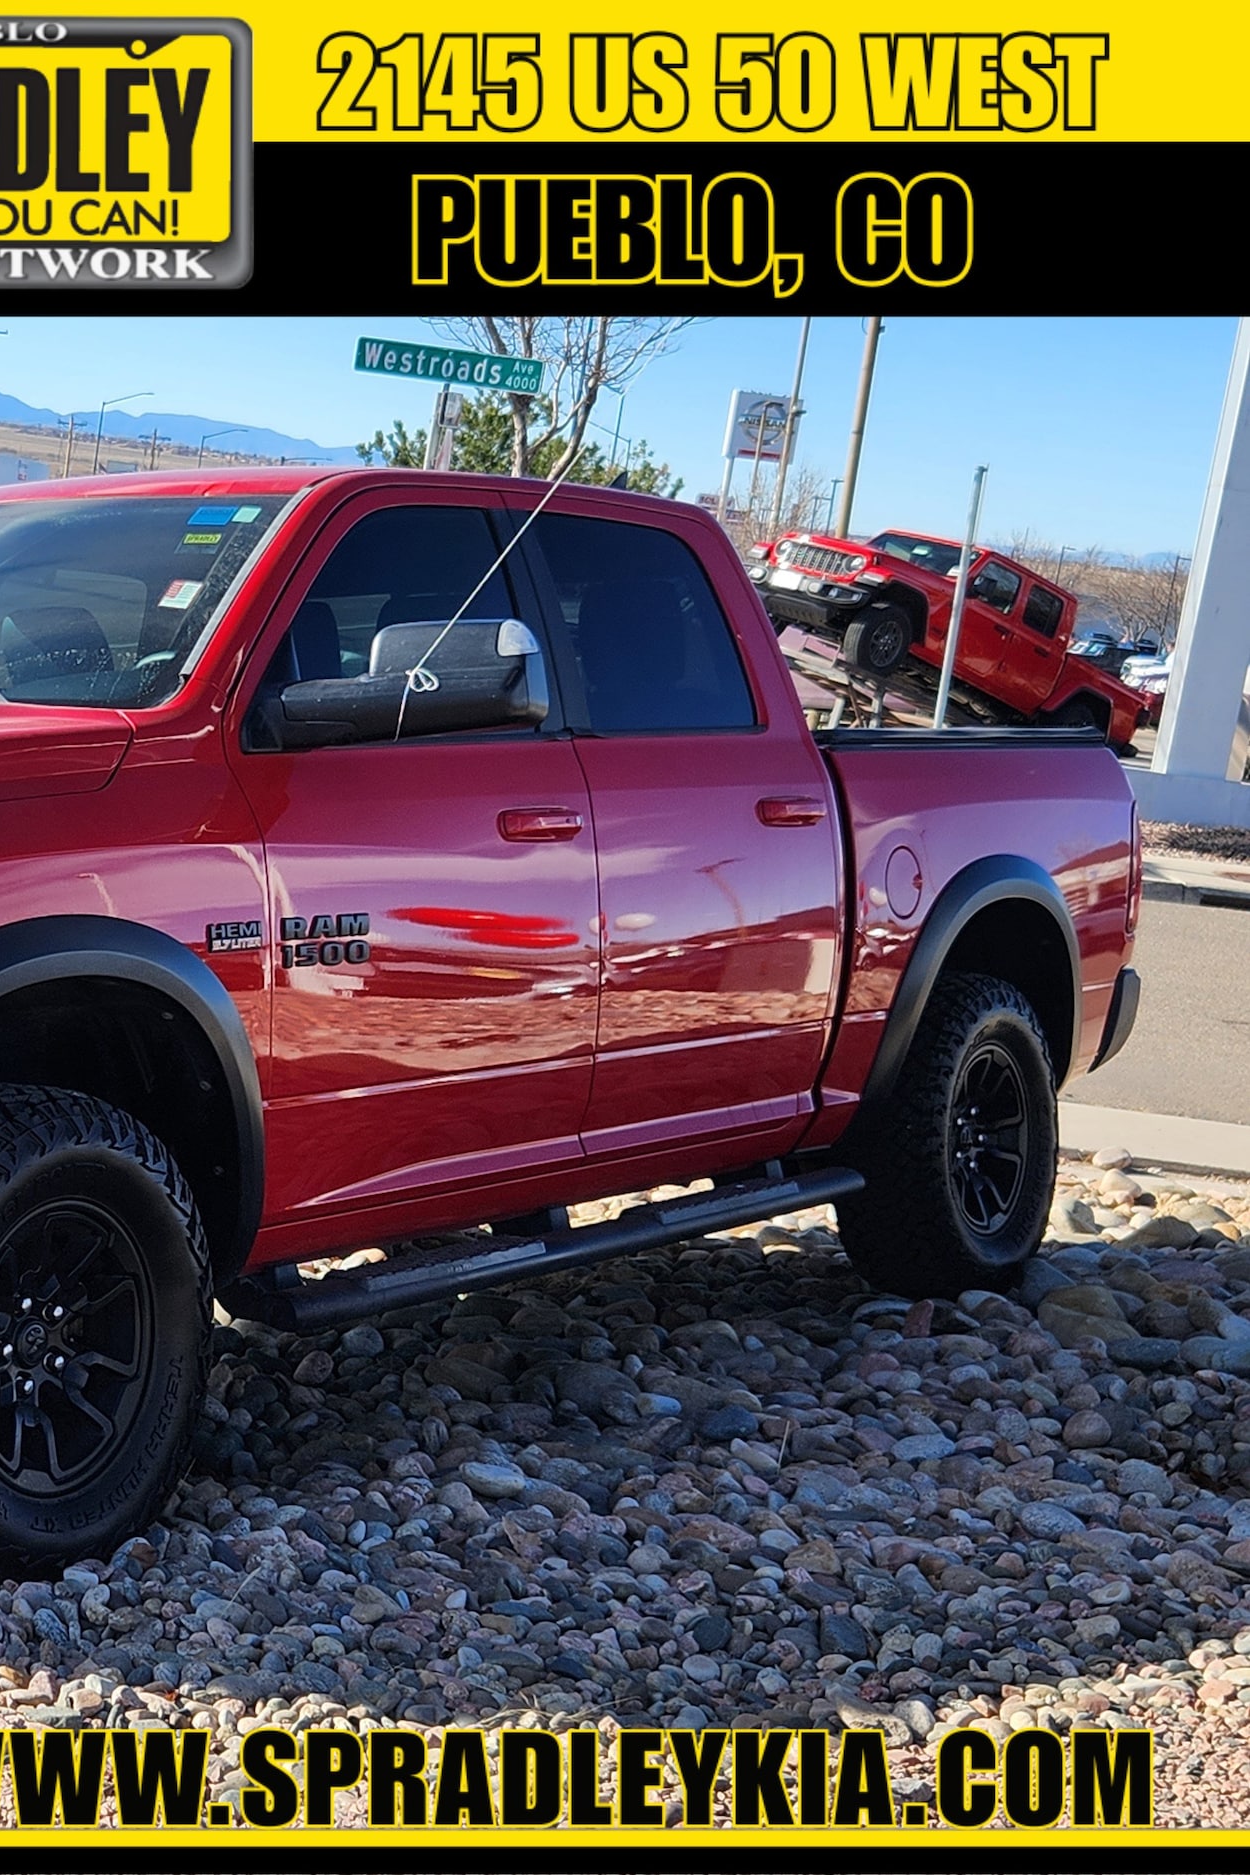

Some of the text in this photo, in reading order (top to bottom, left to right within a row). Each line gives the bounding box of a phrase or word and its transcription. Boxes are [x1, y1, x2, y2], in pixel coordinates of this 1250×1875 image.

[364, 341, 534, 386] Westroads Ave
[505, 376, 539, 391] 4000
[210, 922, 262, 938] HEMI
[283, 912, 370, 941] RAM
[283, 940, 371, 969] 1500
